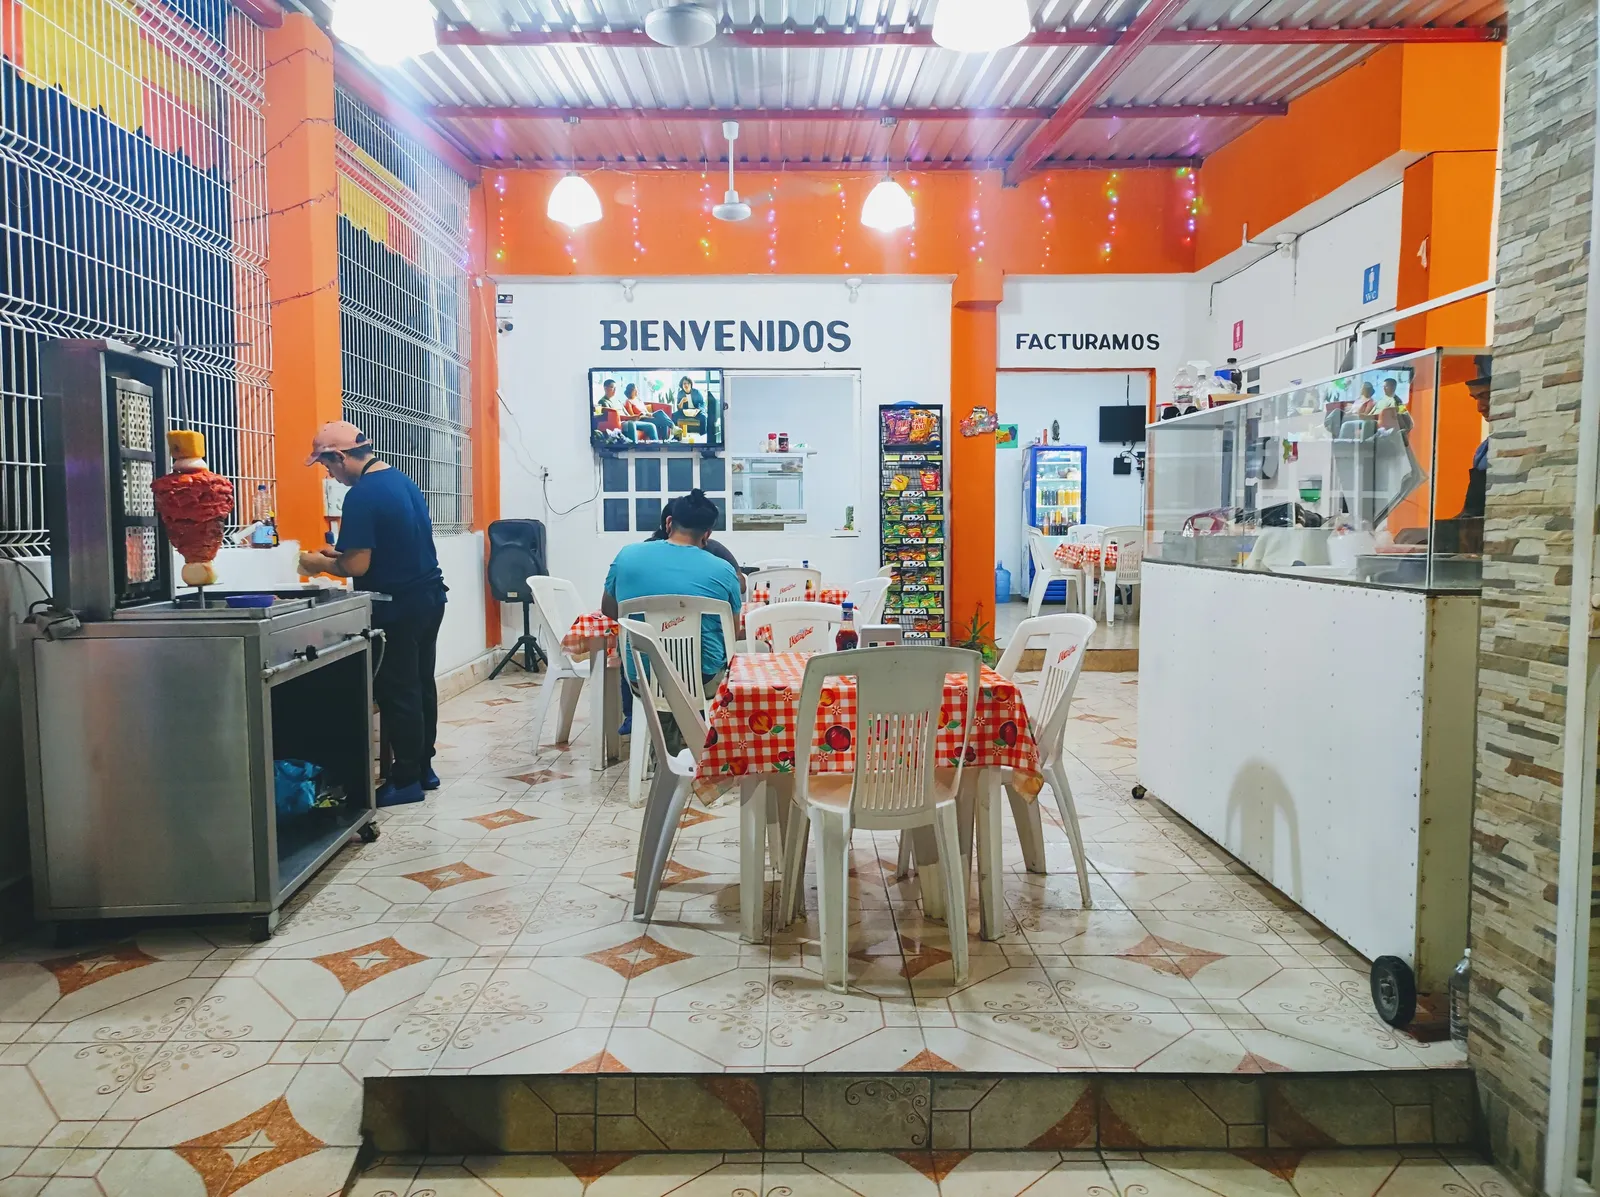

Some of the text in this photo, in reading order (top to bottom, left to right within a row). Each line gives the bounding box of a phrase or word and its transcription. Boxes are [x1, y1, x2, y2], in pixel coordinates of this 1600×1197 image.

[1365, 290, 1377, 302] WC
[599, 319, 852, 353] BIENVENIDOS
[1015, 333, 1161, 351] FACTURAMOS
